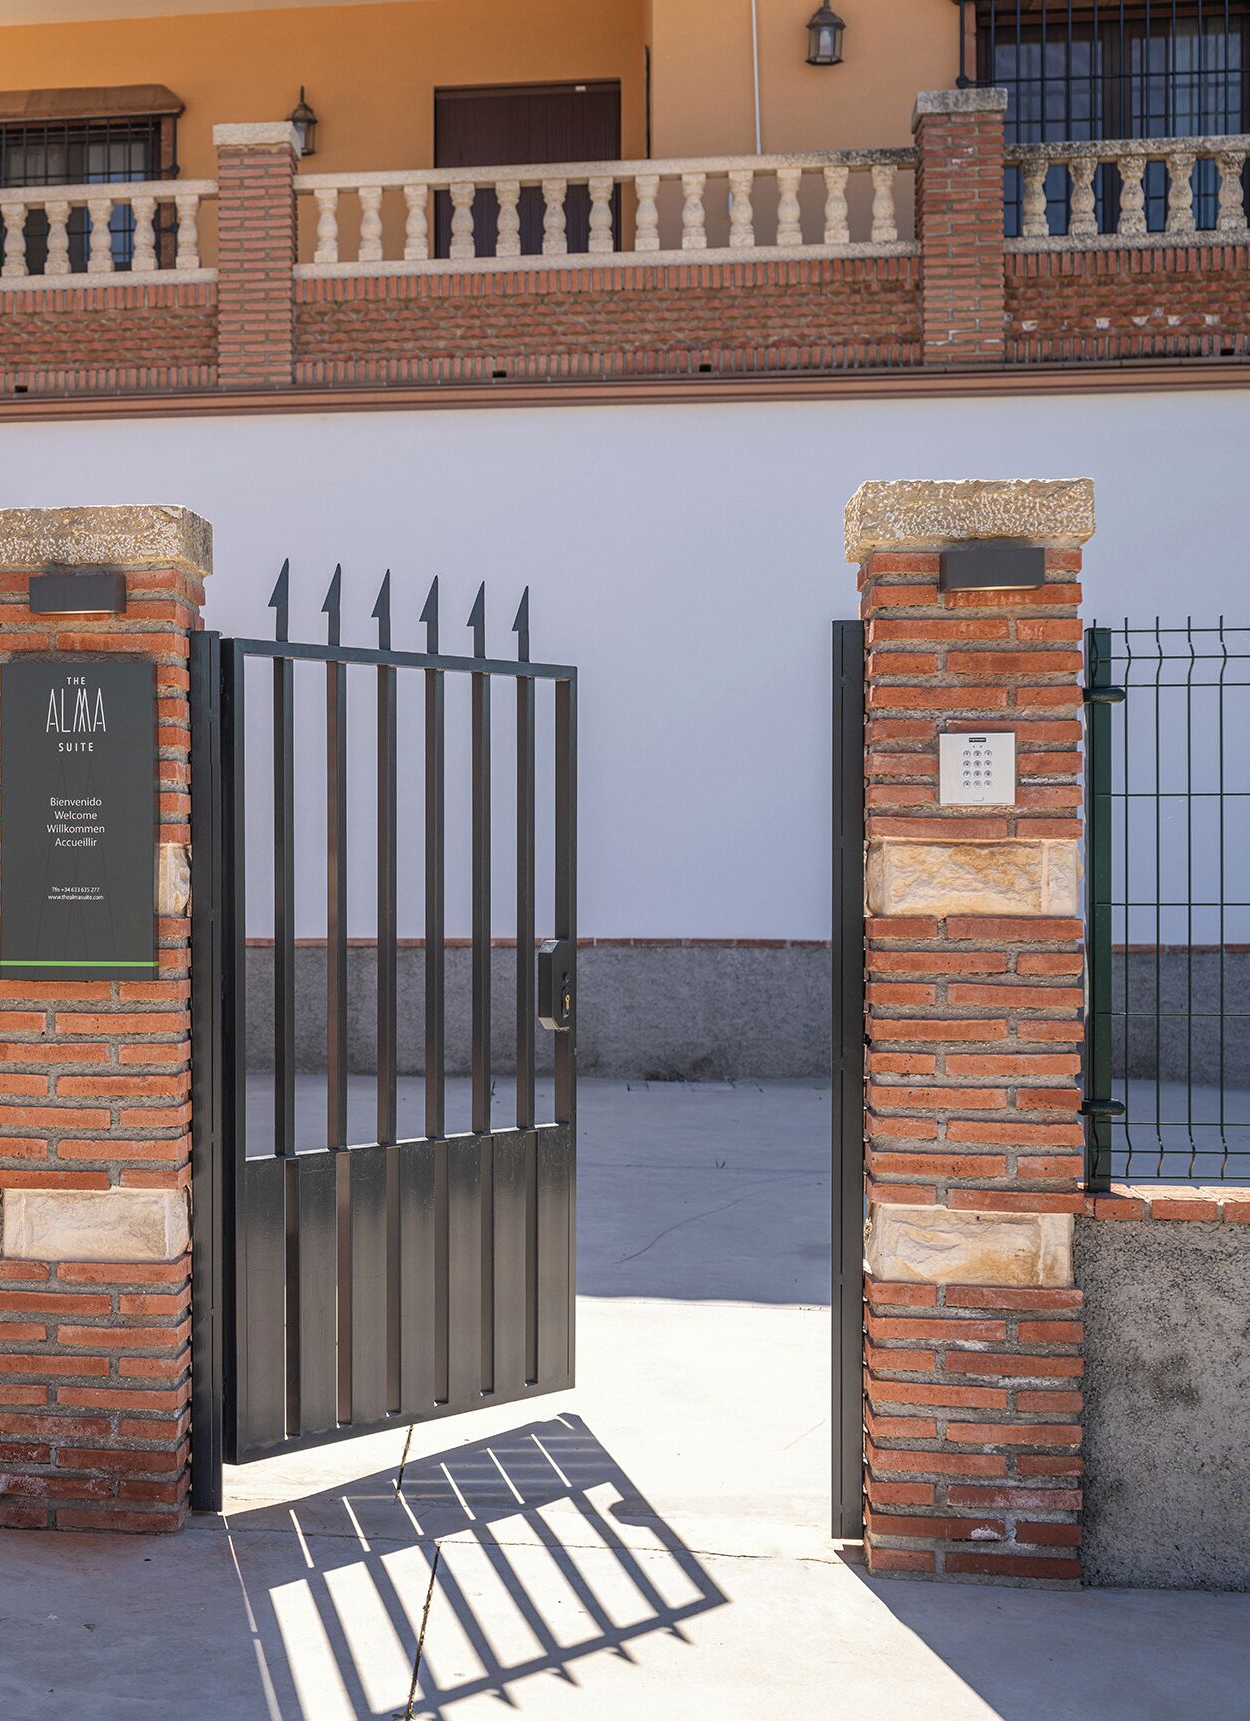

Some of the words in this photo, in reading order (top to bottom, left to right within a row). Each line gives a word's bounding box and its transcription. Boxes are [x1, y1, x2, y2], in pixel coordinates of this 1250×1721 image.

[66, 676, 86, 685] THE
[46, 687, 107, 733] ALMA
[58, 742, 94, 752] SUITE
[50, 796, 103, 806] Bienvenido
[54, 810, 98, 820] Welcome
[46, 824, 105, 833] Willkommen
[54, 837, 98, 847] Accueillir
